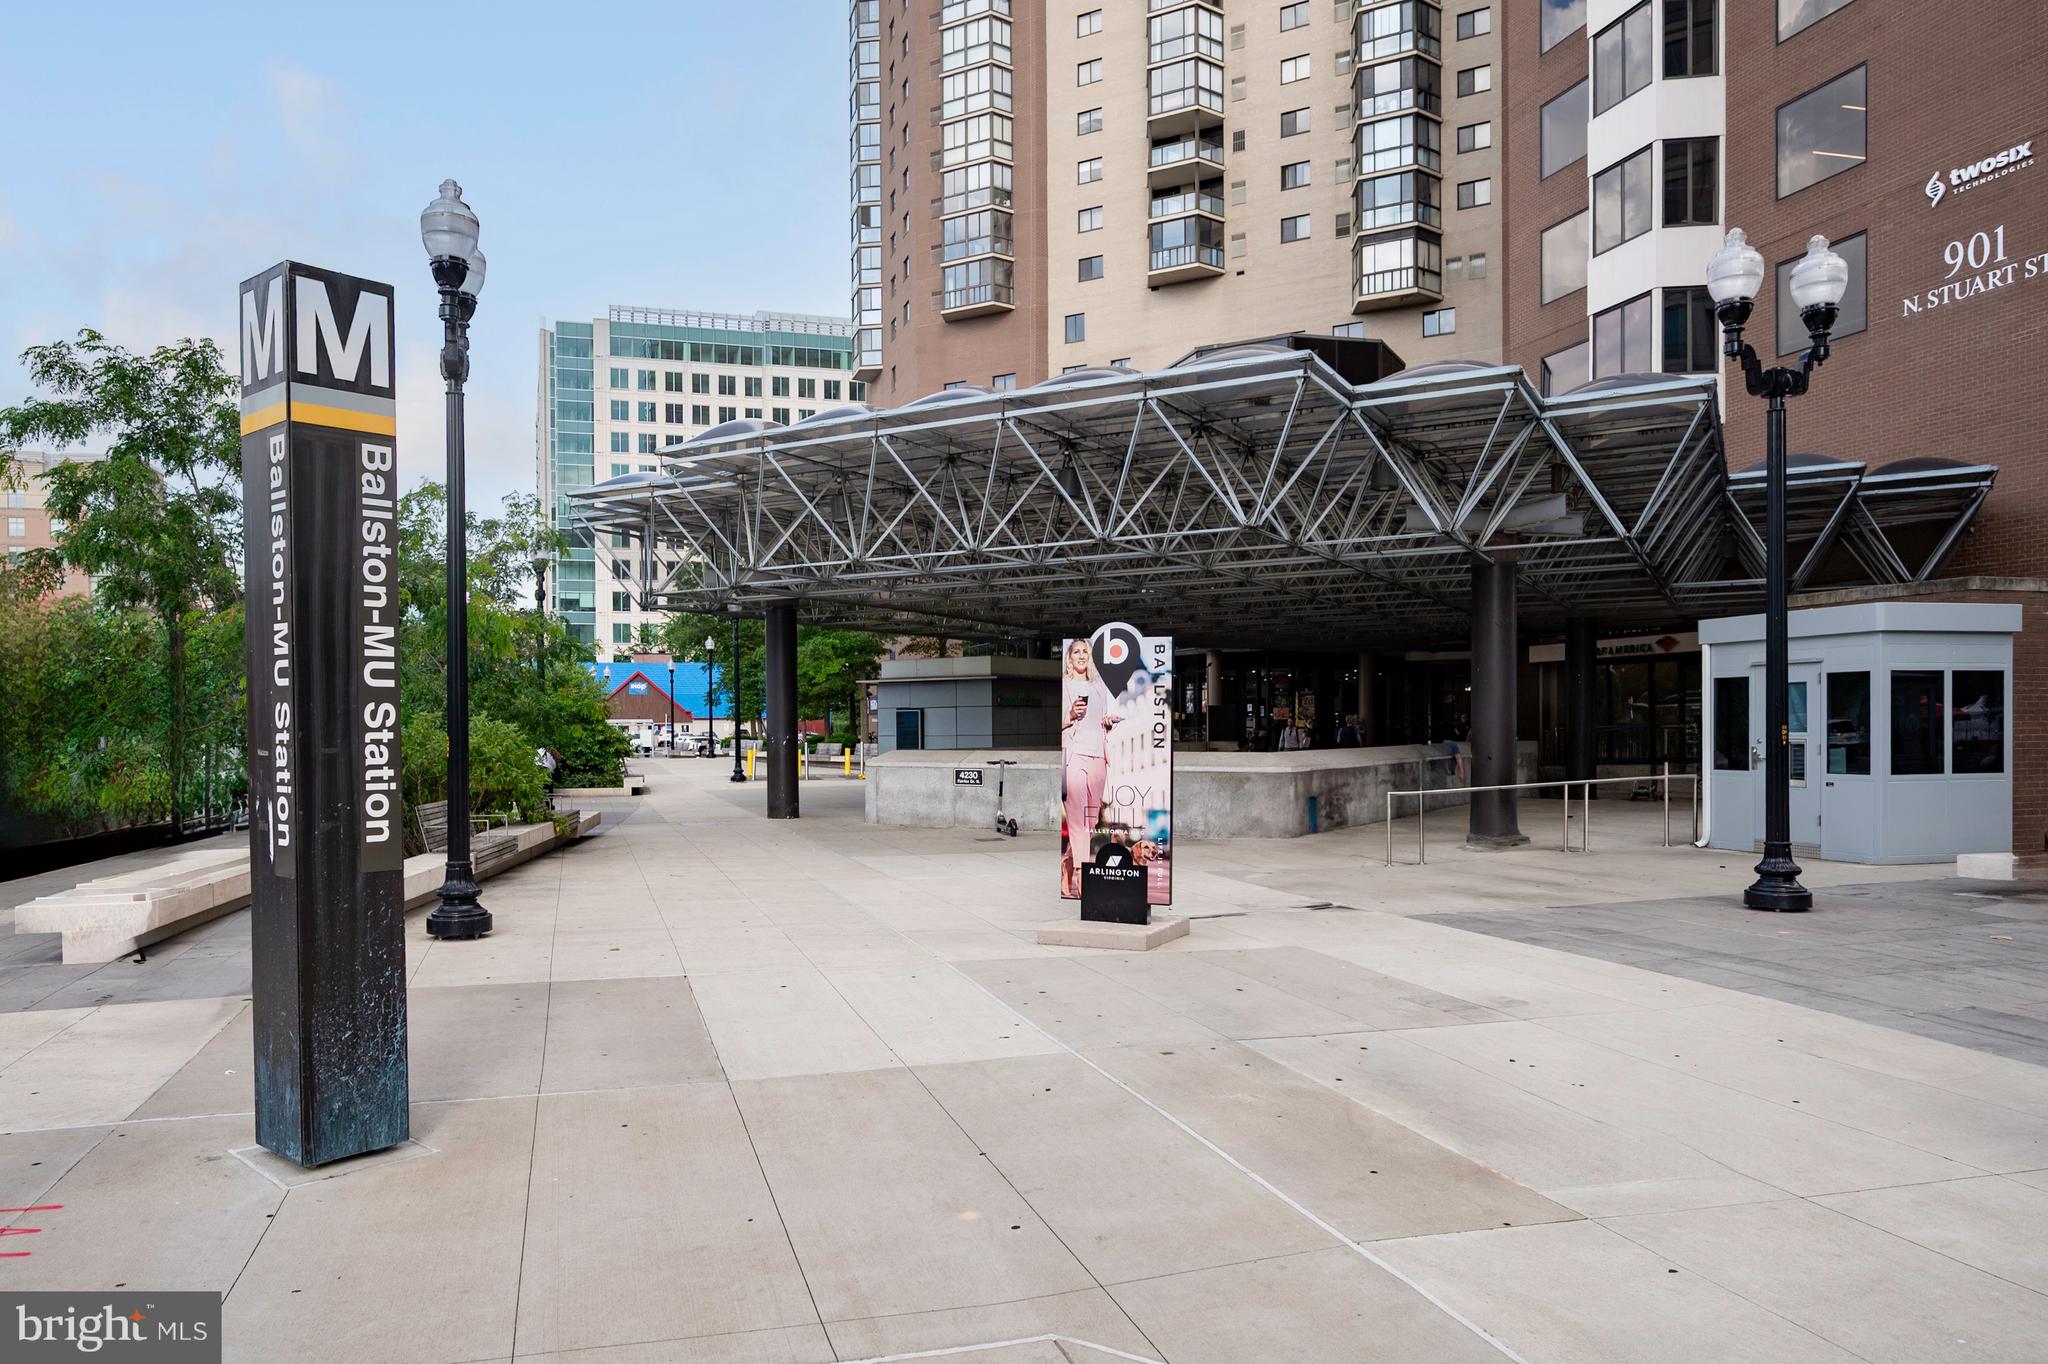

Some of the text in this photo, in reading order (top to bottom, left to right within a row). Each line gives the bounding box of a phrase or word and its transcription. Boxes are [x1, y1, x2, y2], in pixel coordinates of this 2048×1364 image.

[1949, 140, 2033, 186] twosix
[1952, 158, 2035, 195] TECHNOLOGIES
[1944, 224, 2008, 279] 901
[1902, 295, 1923, 317] N.
[1927, 263, 2018, 309] STUART
[241, 275, 284, 387] M
[295, 275, 390, 388] M
[269, 433, 292, 847] Ballston-MU Station
[361, 443, 397, 843] Ballston-MU Station
[959, 771, 978, 779] 4230
[1089, 867, 1140, 878] ARLINGTON
